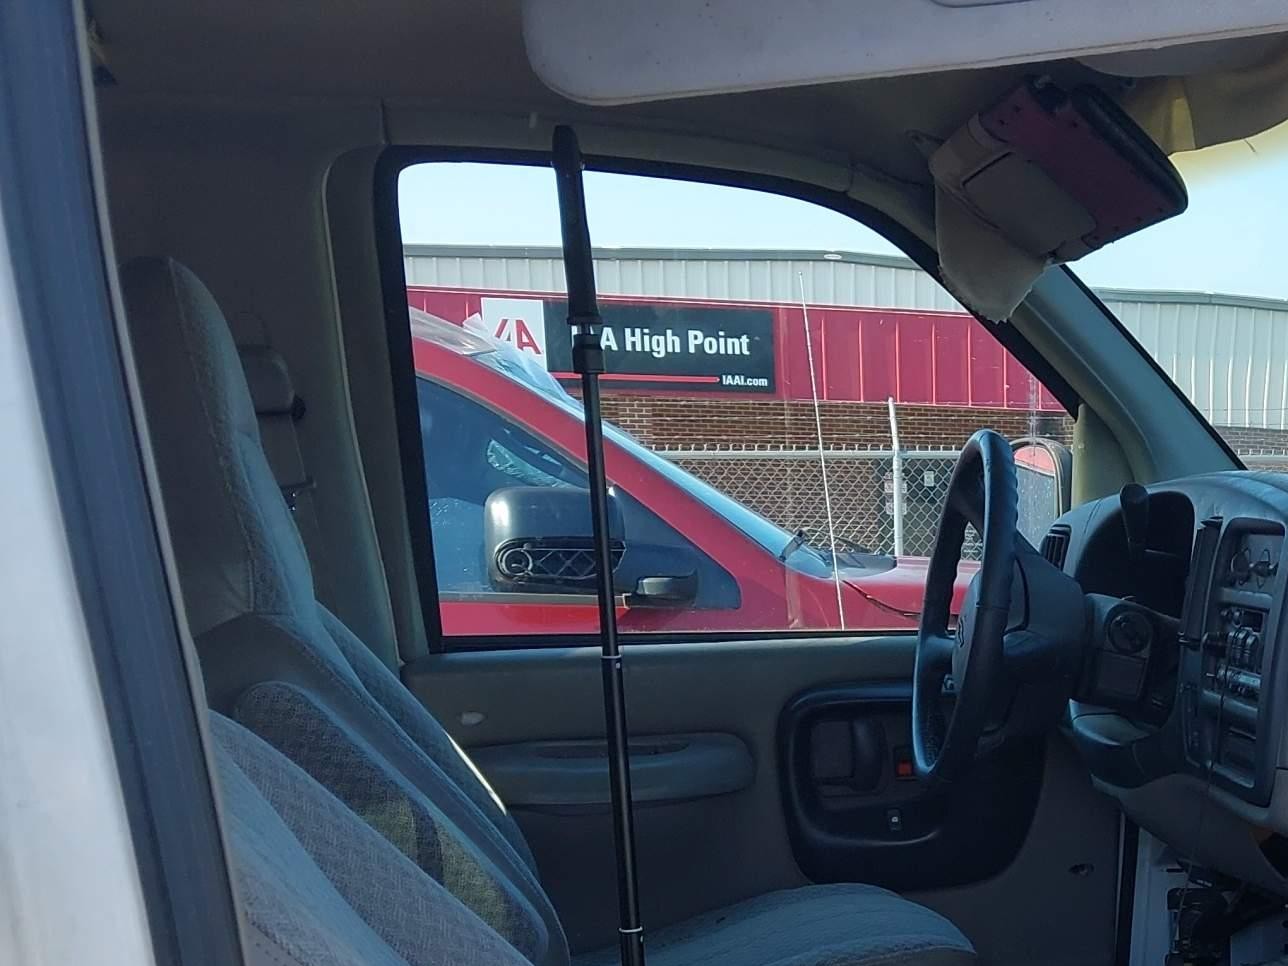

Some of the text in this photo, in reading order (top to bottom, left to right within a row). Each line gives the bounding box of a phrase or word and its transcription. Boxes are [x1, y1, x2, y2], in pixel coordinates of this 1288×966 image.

[624, 327, 681, 358] High
[687, 329, 750, 356] Point
[722, 374, 768, 387] IAAI.com
